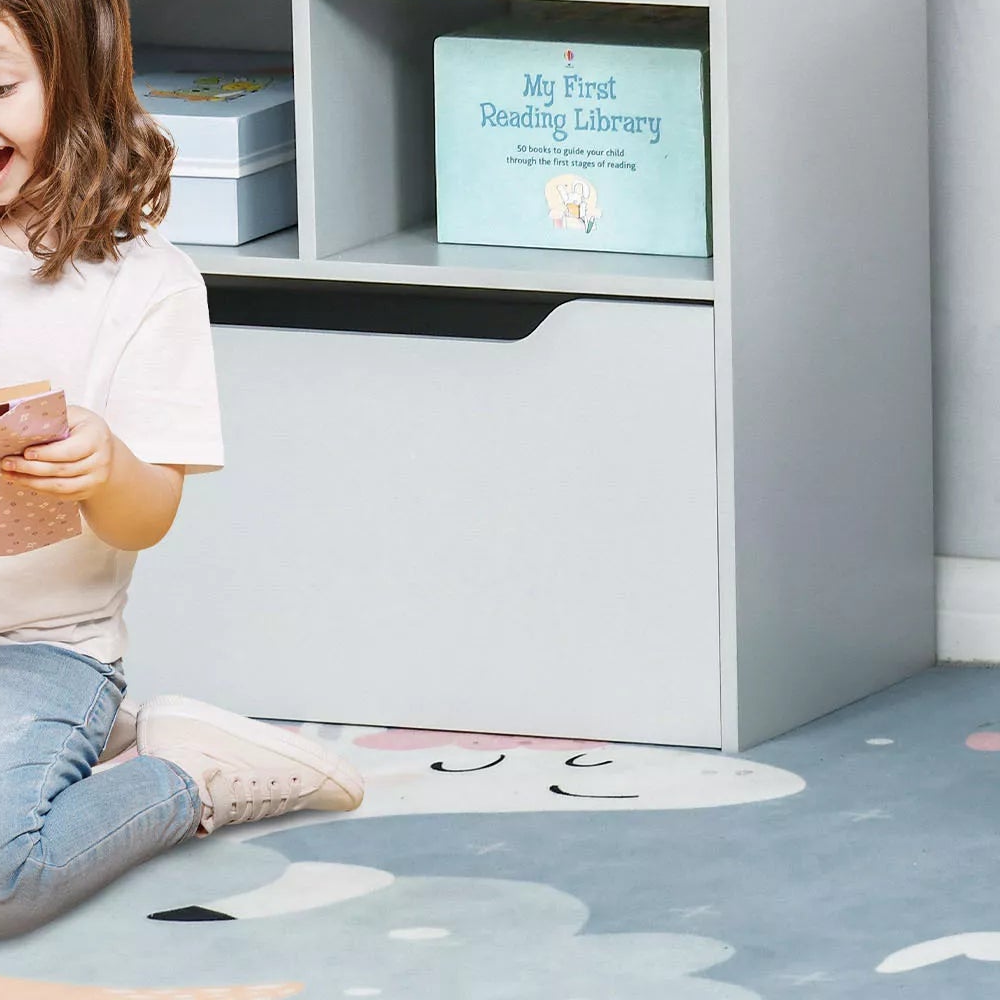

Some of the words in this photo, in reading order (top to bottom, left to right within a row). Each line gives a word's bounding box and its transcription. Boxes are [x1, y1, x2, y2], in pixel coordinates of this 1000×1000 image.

[522, 73, 555, 107] My
[563, 73, 617, 99] First
[479, 102, 568, 142] Reading
[574, 107, 662, 144] Library
[506, 156, 537, 166] through
[539, 157, 551, 165] the
[553, 157, 569, 166] first
[571, 159, 595, 169] stages
[597, 160, 606, 168] of
[607, 161, 636, 171] reading
[517, 145, 527, 153] 50
[528, 145, 551, 154] books
[563, 147, 584, 156] guide
[586, 149, 604, 158] your
[605, 149, 624, 157] child
